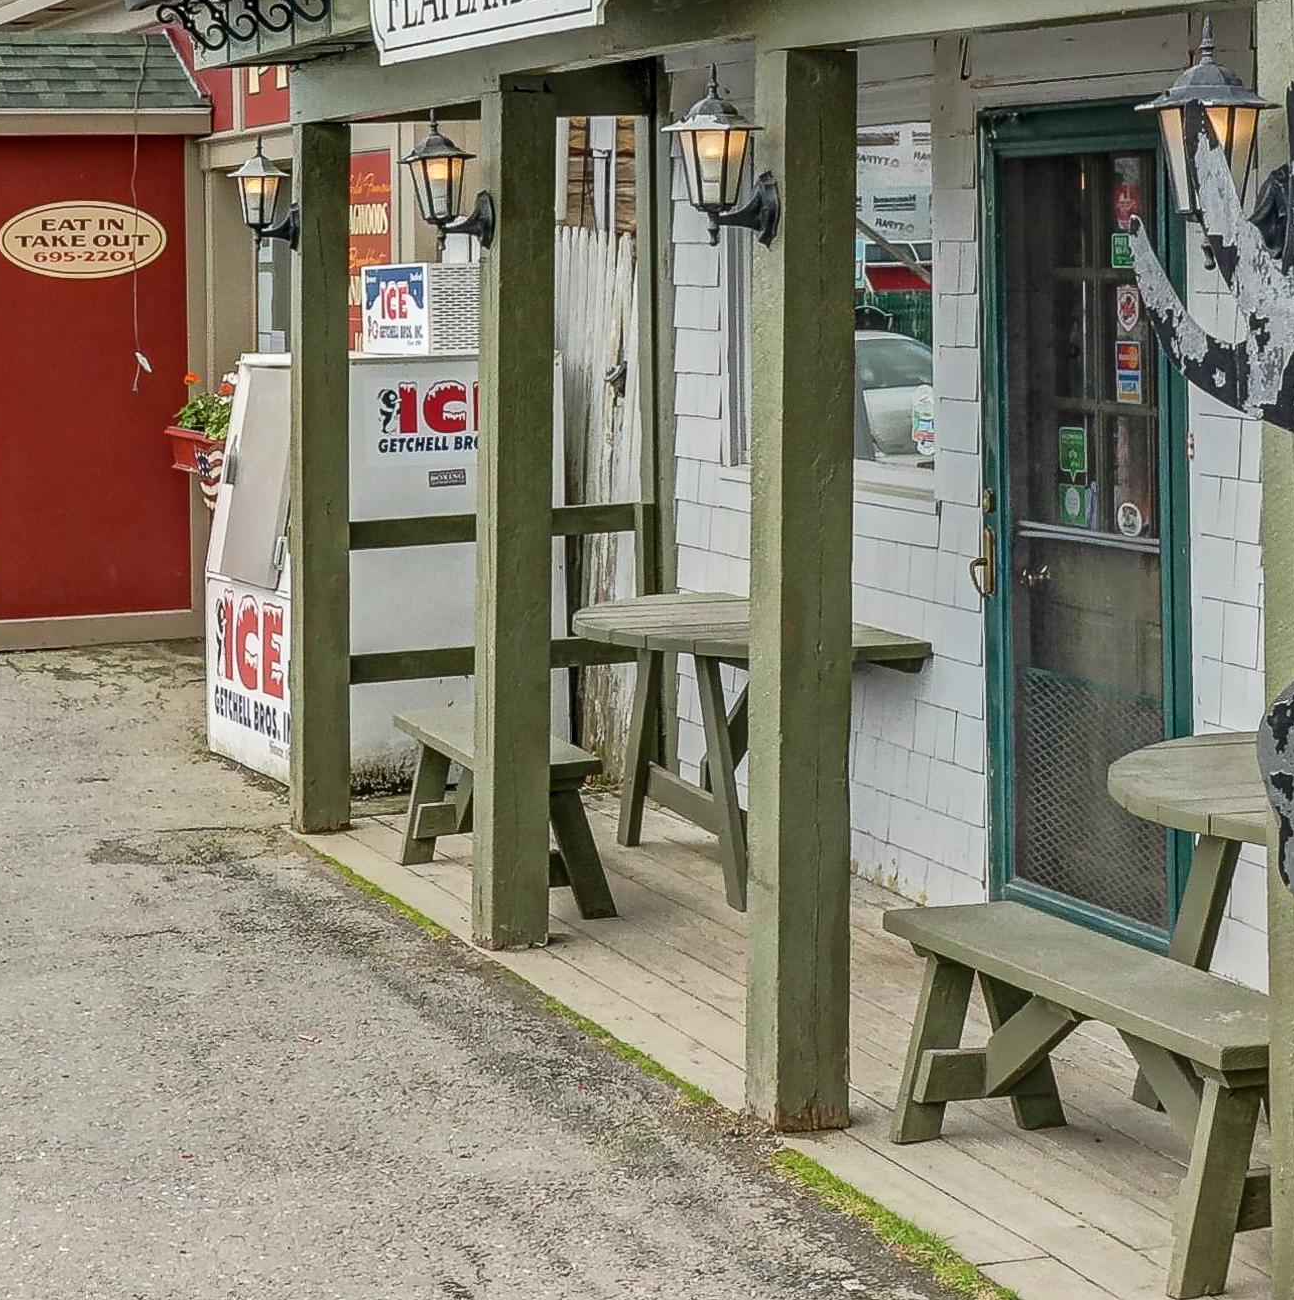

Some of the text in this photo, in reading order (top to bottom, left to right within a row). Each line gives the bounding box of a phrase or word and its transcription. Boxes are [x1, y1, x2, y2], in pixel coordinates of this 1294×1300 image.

[41, 218, 124, 231] EAT IN
[15, 234, 150, 247] TAKE OUT
[33, 251, 136, 263] 695-2201
[379, 280, 409, 320] ICE
[378, 436, 450, 454] GETCHELL
[224, 589, 284, 700] ICE
[215, 684, 252, 728] GETCHELL
